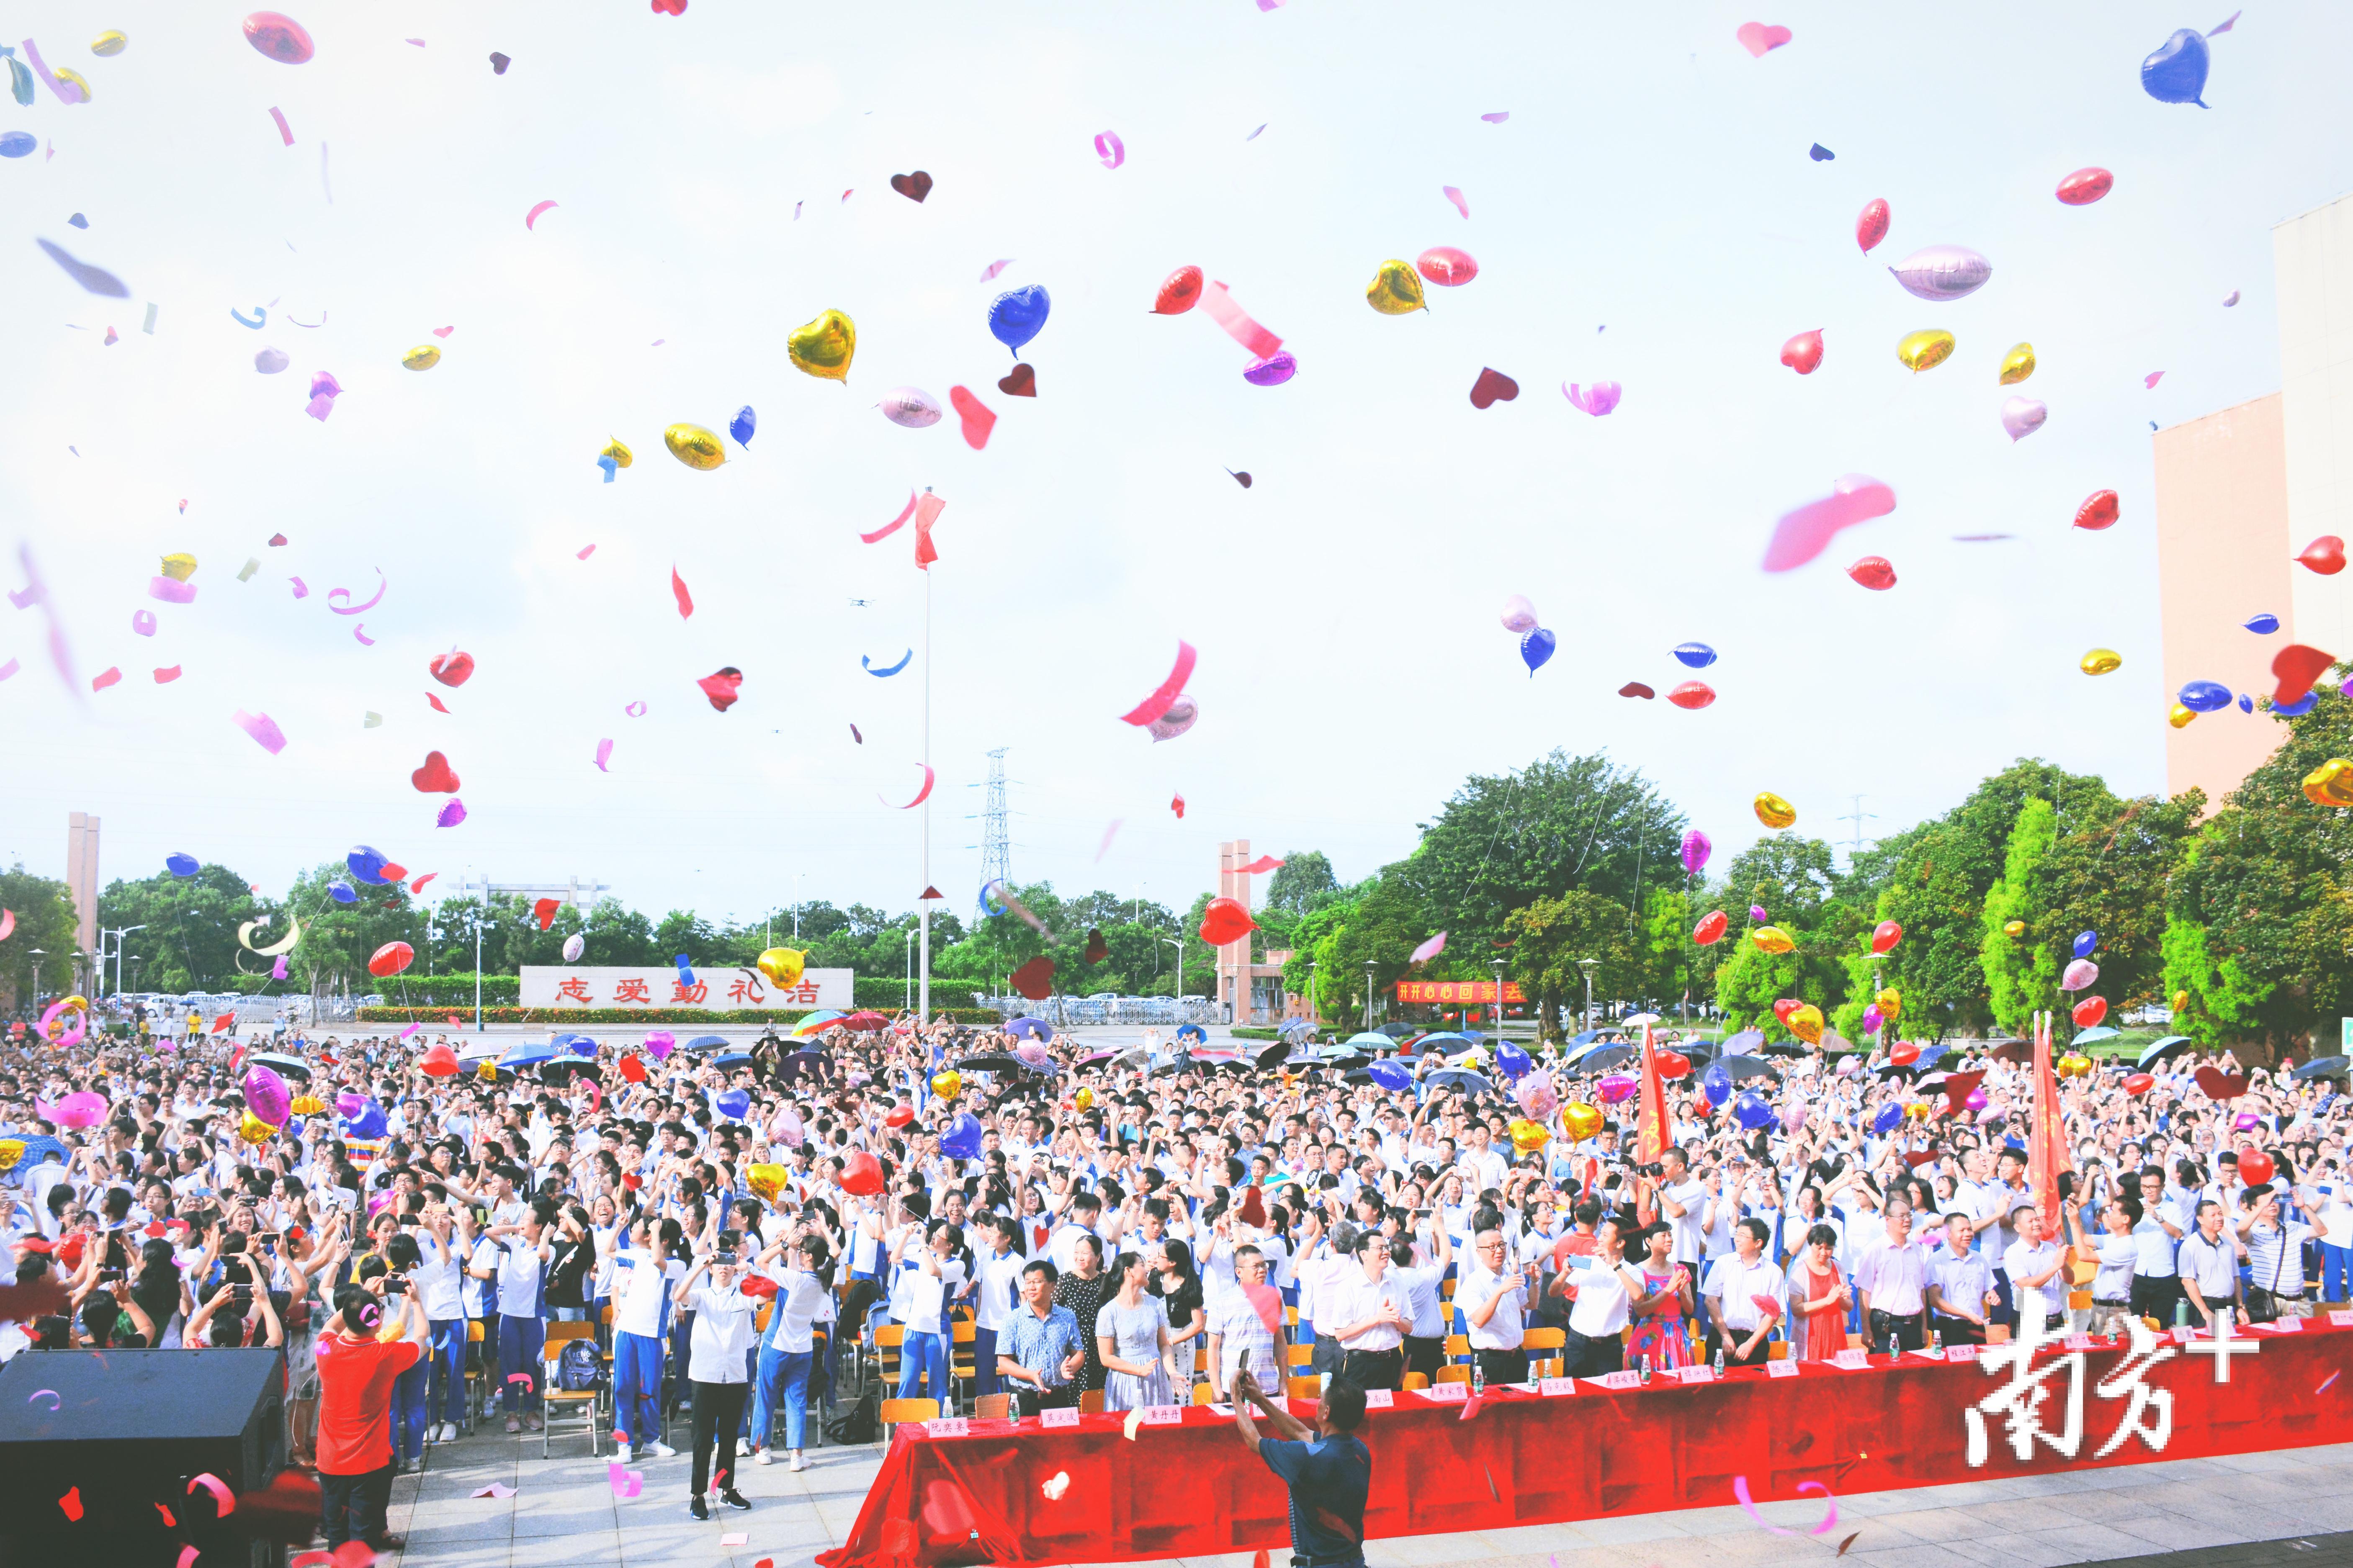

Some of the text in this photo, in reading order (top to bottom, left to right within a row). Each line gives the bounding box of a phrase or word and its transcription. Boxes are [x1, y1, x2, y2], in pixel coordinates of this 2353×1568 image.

[1400, 984, 1522, 1000] 开开心心回家去
[1150, 1409, 1179, 1420] 黄丹丹
